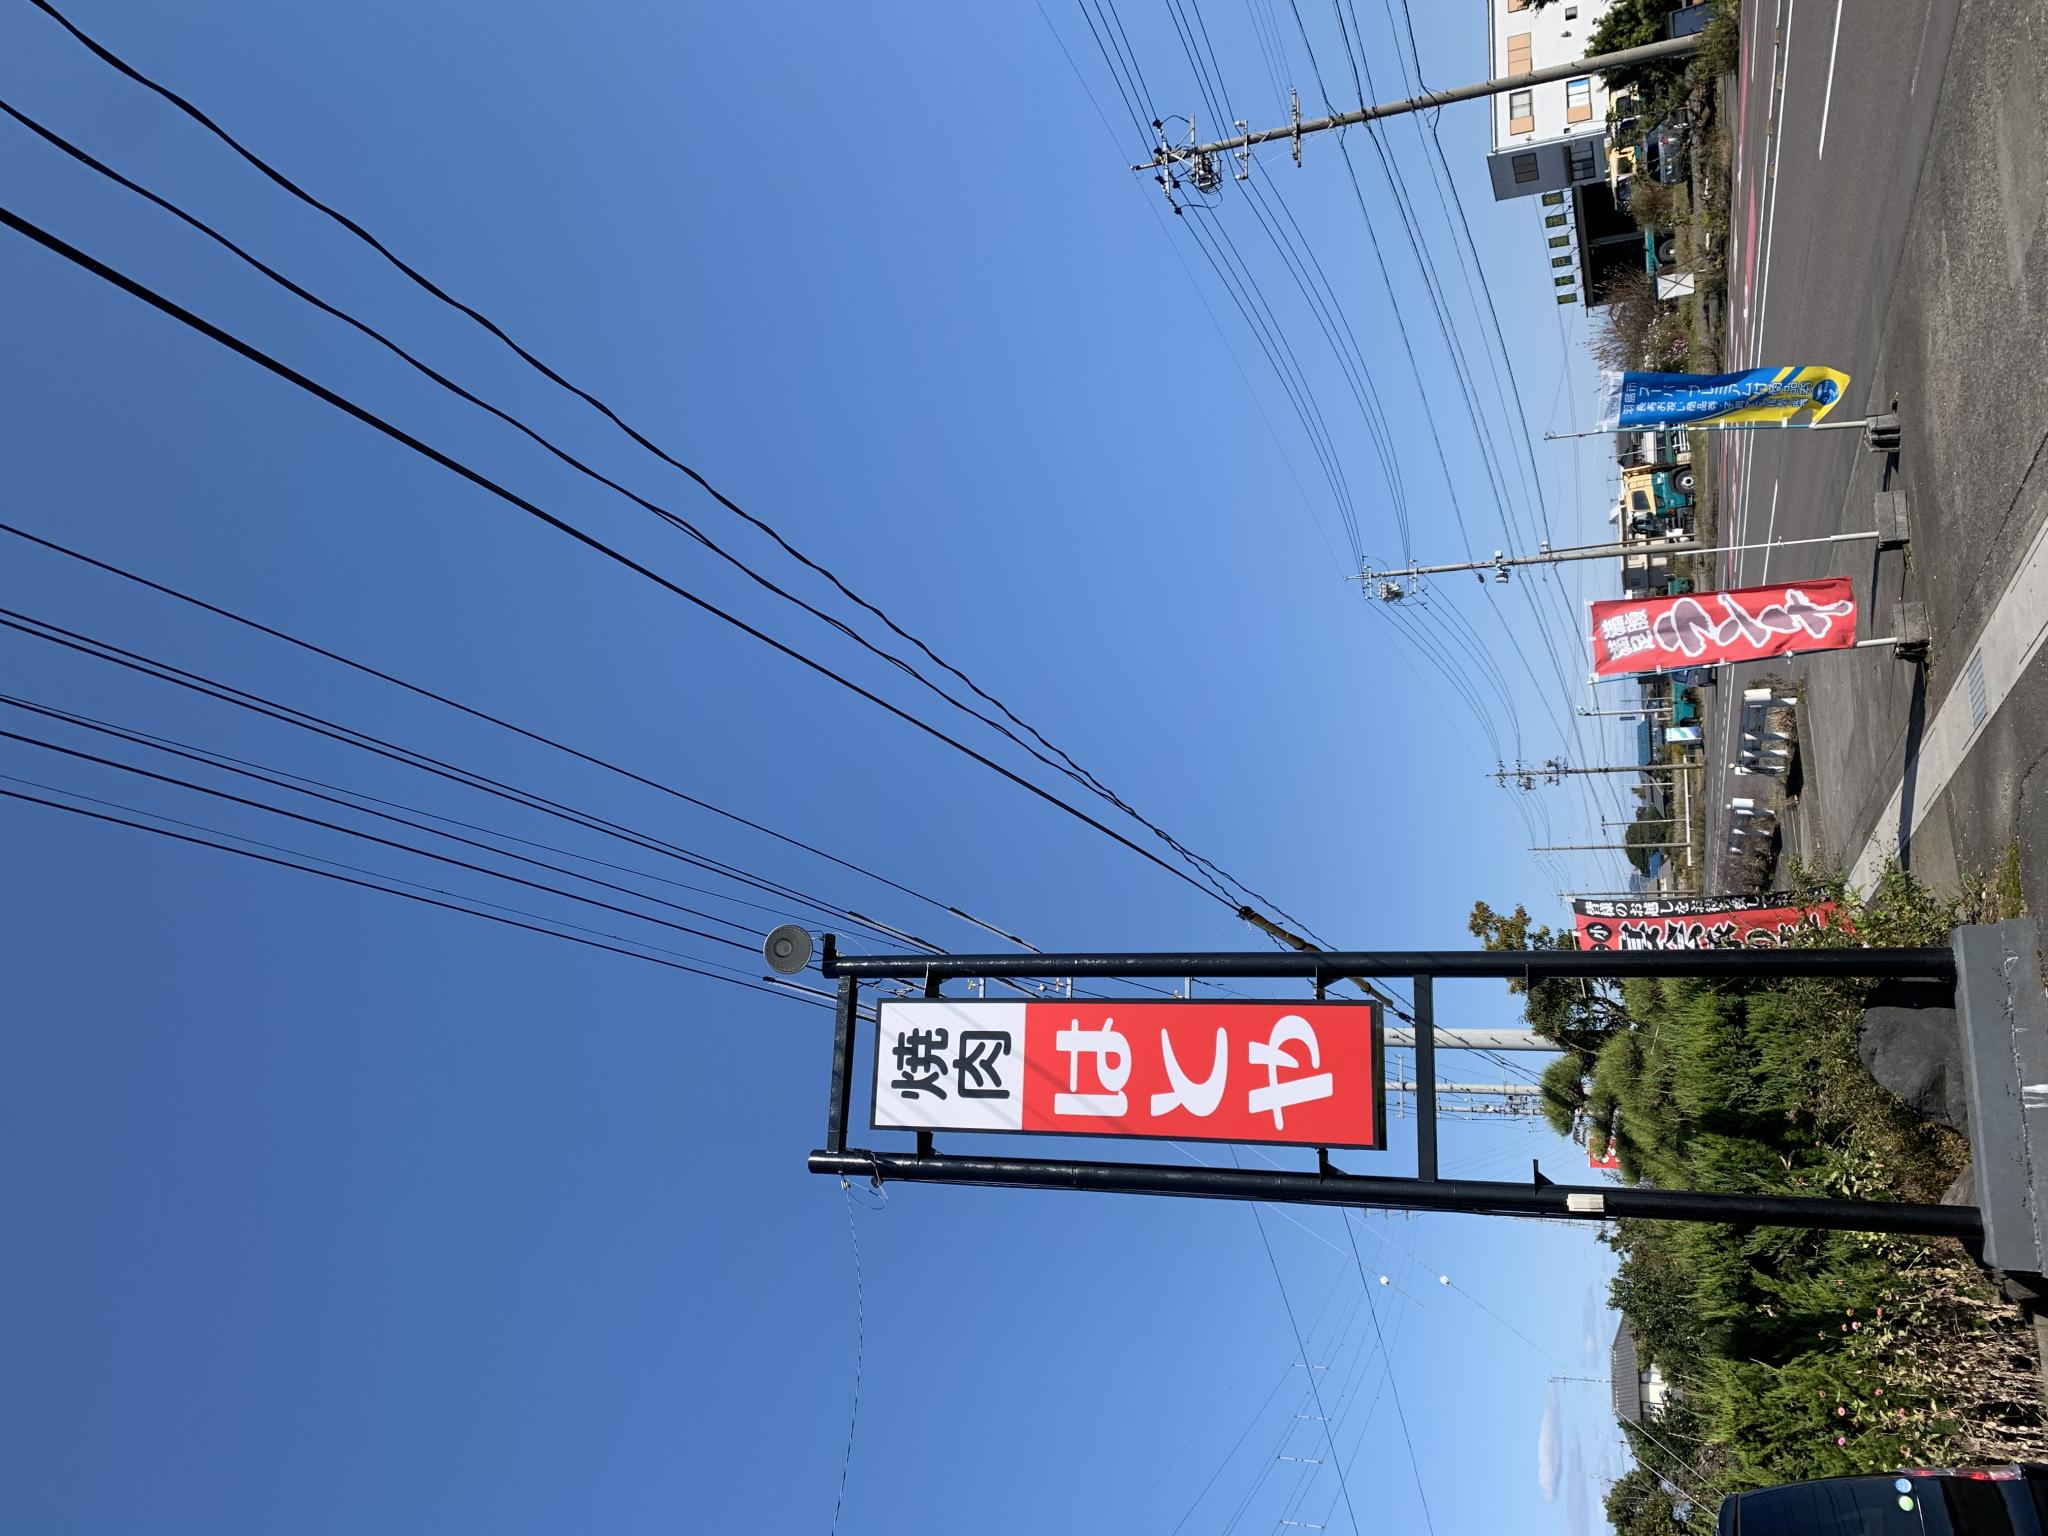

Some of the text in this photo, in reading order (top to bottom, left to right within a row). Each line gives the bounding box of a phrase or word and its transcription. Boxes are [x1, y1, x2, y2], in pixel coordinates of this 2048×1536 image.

[1623, 382, 1638, 415] 羽島市
[1653, 589, 1853, 657] ランチ
[892, 1028, 1011, 1099] 焼肉
[1054, 1015, 1333, 1130] はとや
